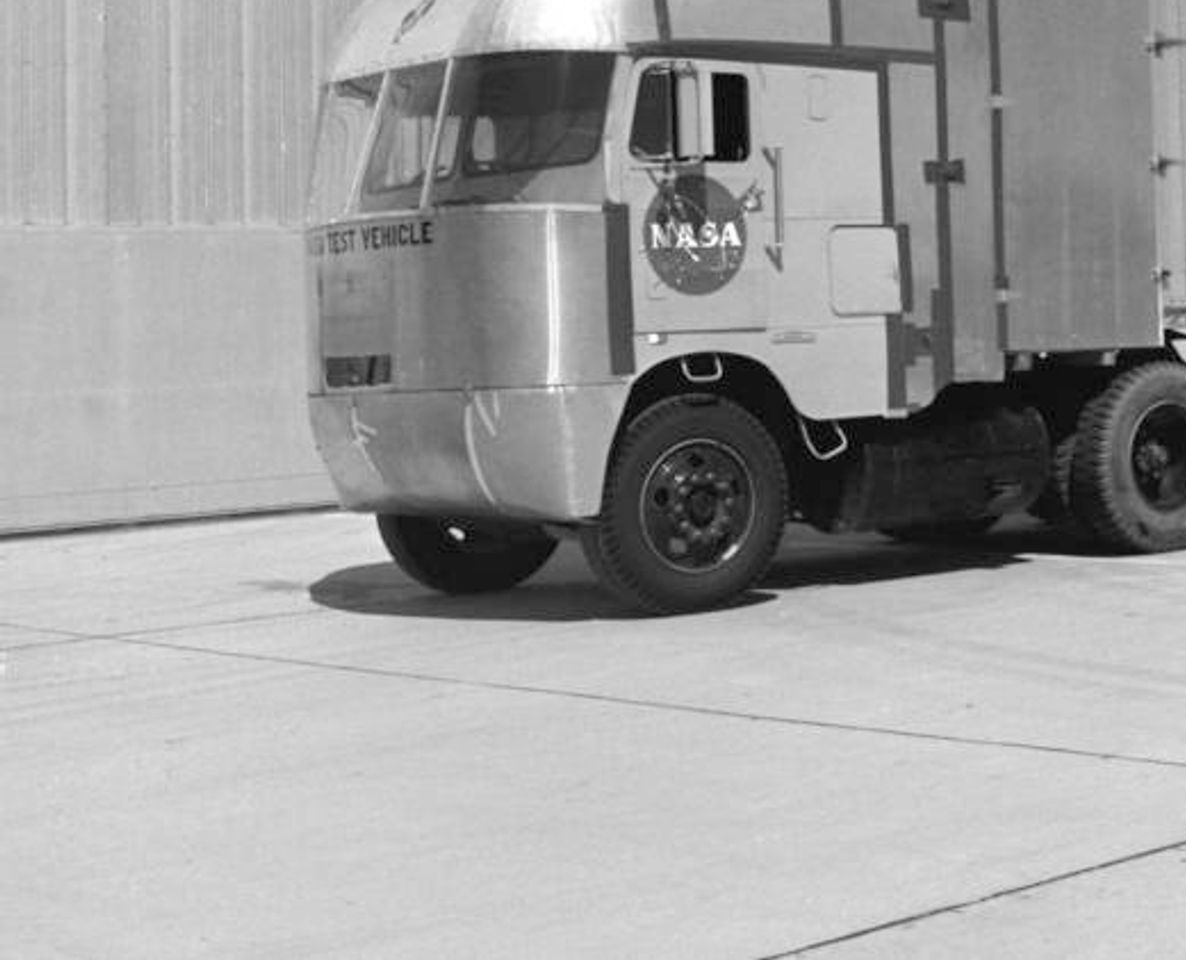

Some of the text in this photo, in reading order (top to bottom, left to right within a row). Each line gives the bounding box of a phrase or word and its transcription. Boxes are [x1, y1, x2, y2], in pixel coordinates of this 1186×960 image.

[327, 229, 355, 254] TEST
[360, 221, 434, 250] VEHICLE
[649, 220, 742, 249] NASA
